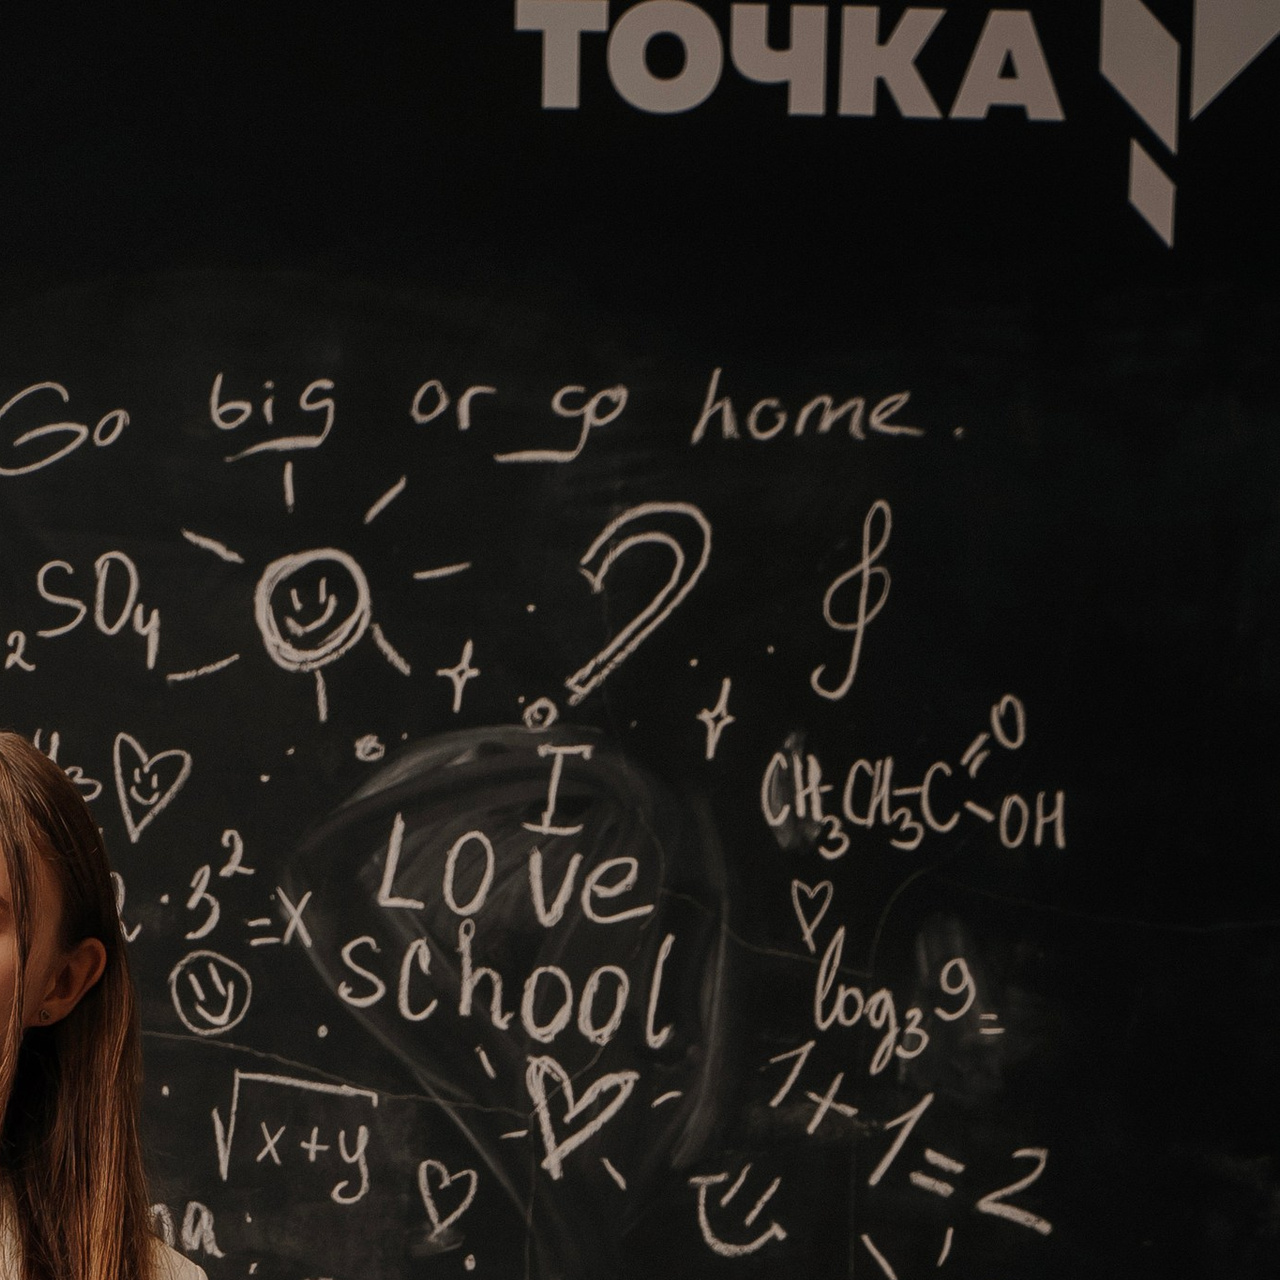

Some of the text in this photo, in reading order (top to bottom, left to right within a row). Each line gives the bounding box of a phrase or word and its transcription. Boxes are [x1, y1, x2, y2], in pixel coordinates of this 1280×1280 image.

[514, 0, 1066, 121] ТОЧКА
[209, 373, 335, 462] big
[411, 379, 497, 431] or
[494, 383, 628, 462] go
[523, 743, 595, 836] I
